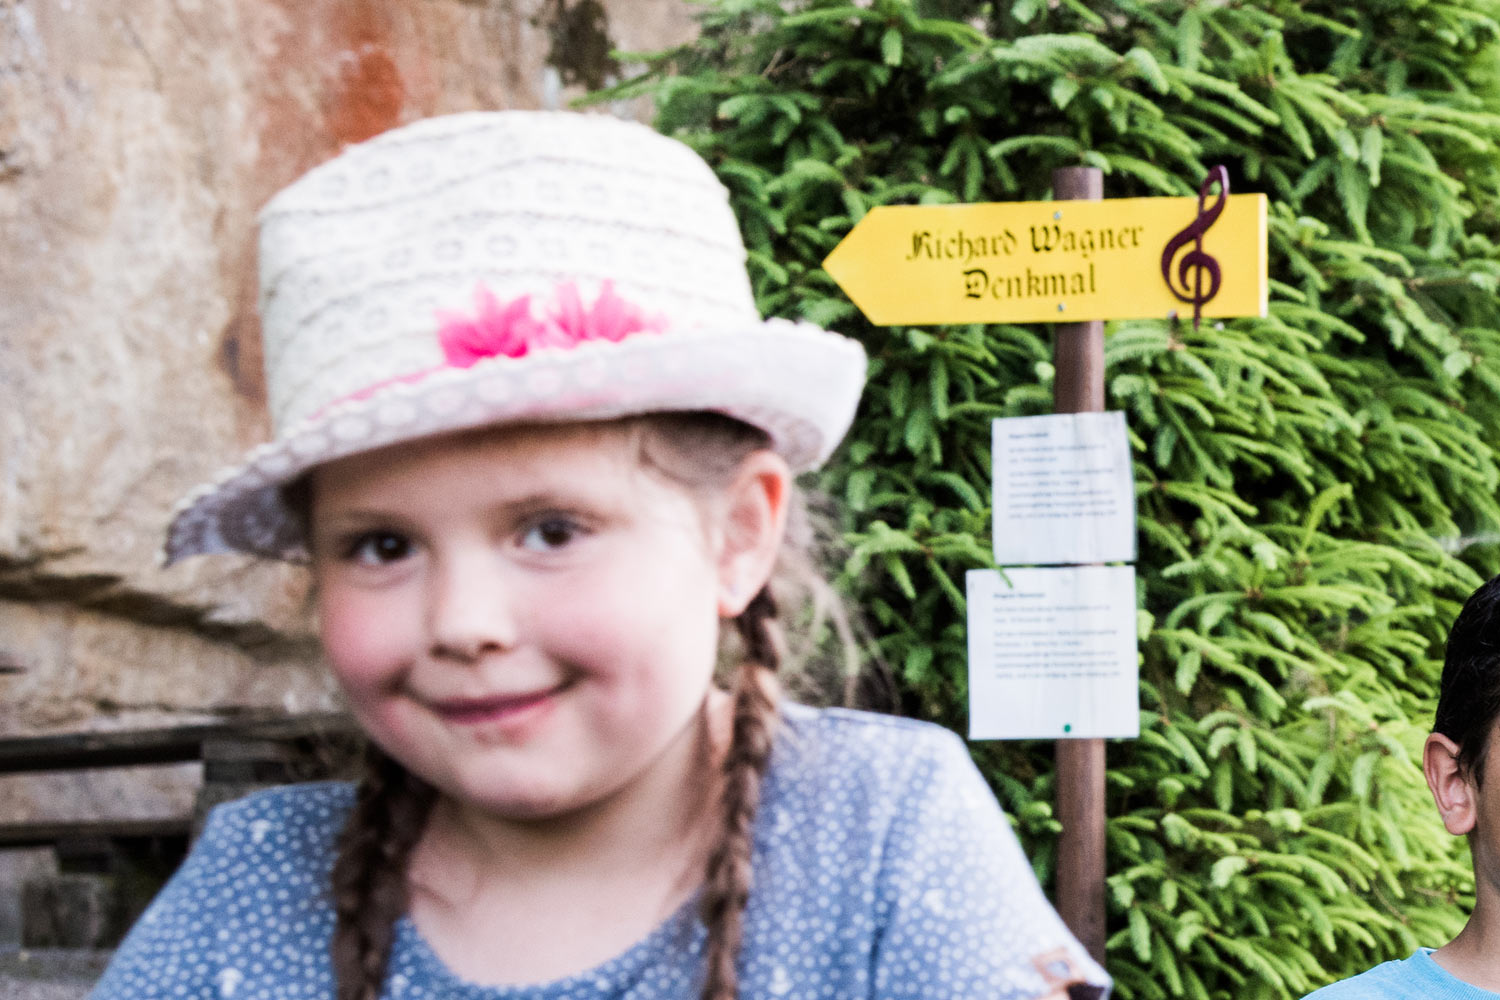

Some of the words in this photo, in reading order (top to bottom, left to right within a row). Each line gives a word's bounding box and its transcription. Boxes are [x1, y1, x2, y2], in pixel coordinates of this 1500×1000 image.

[906, 228, 1018, 264] Richard
[1030, 224, 1143, 258] Wagner
[963, 262, 1096, 298] Denkmal
